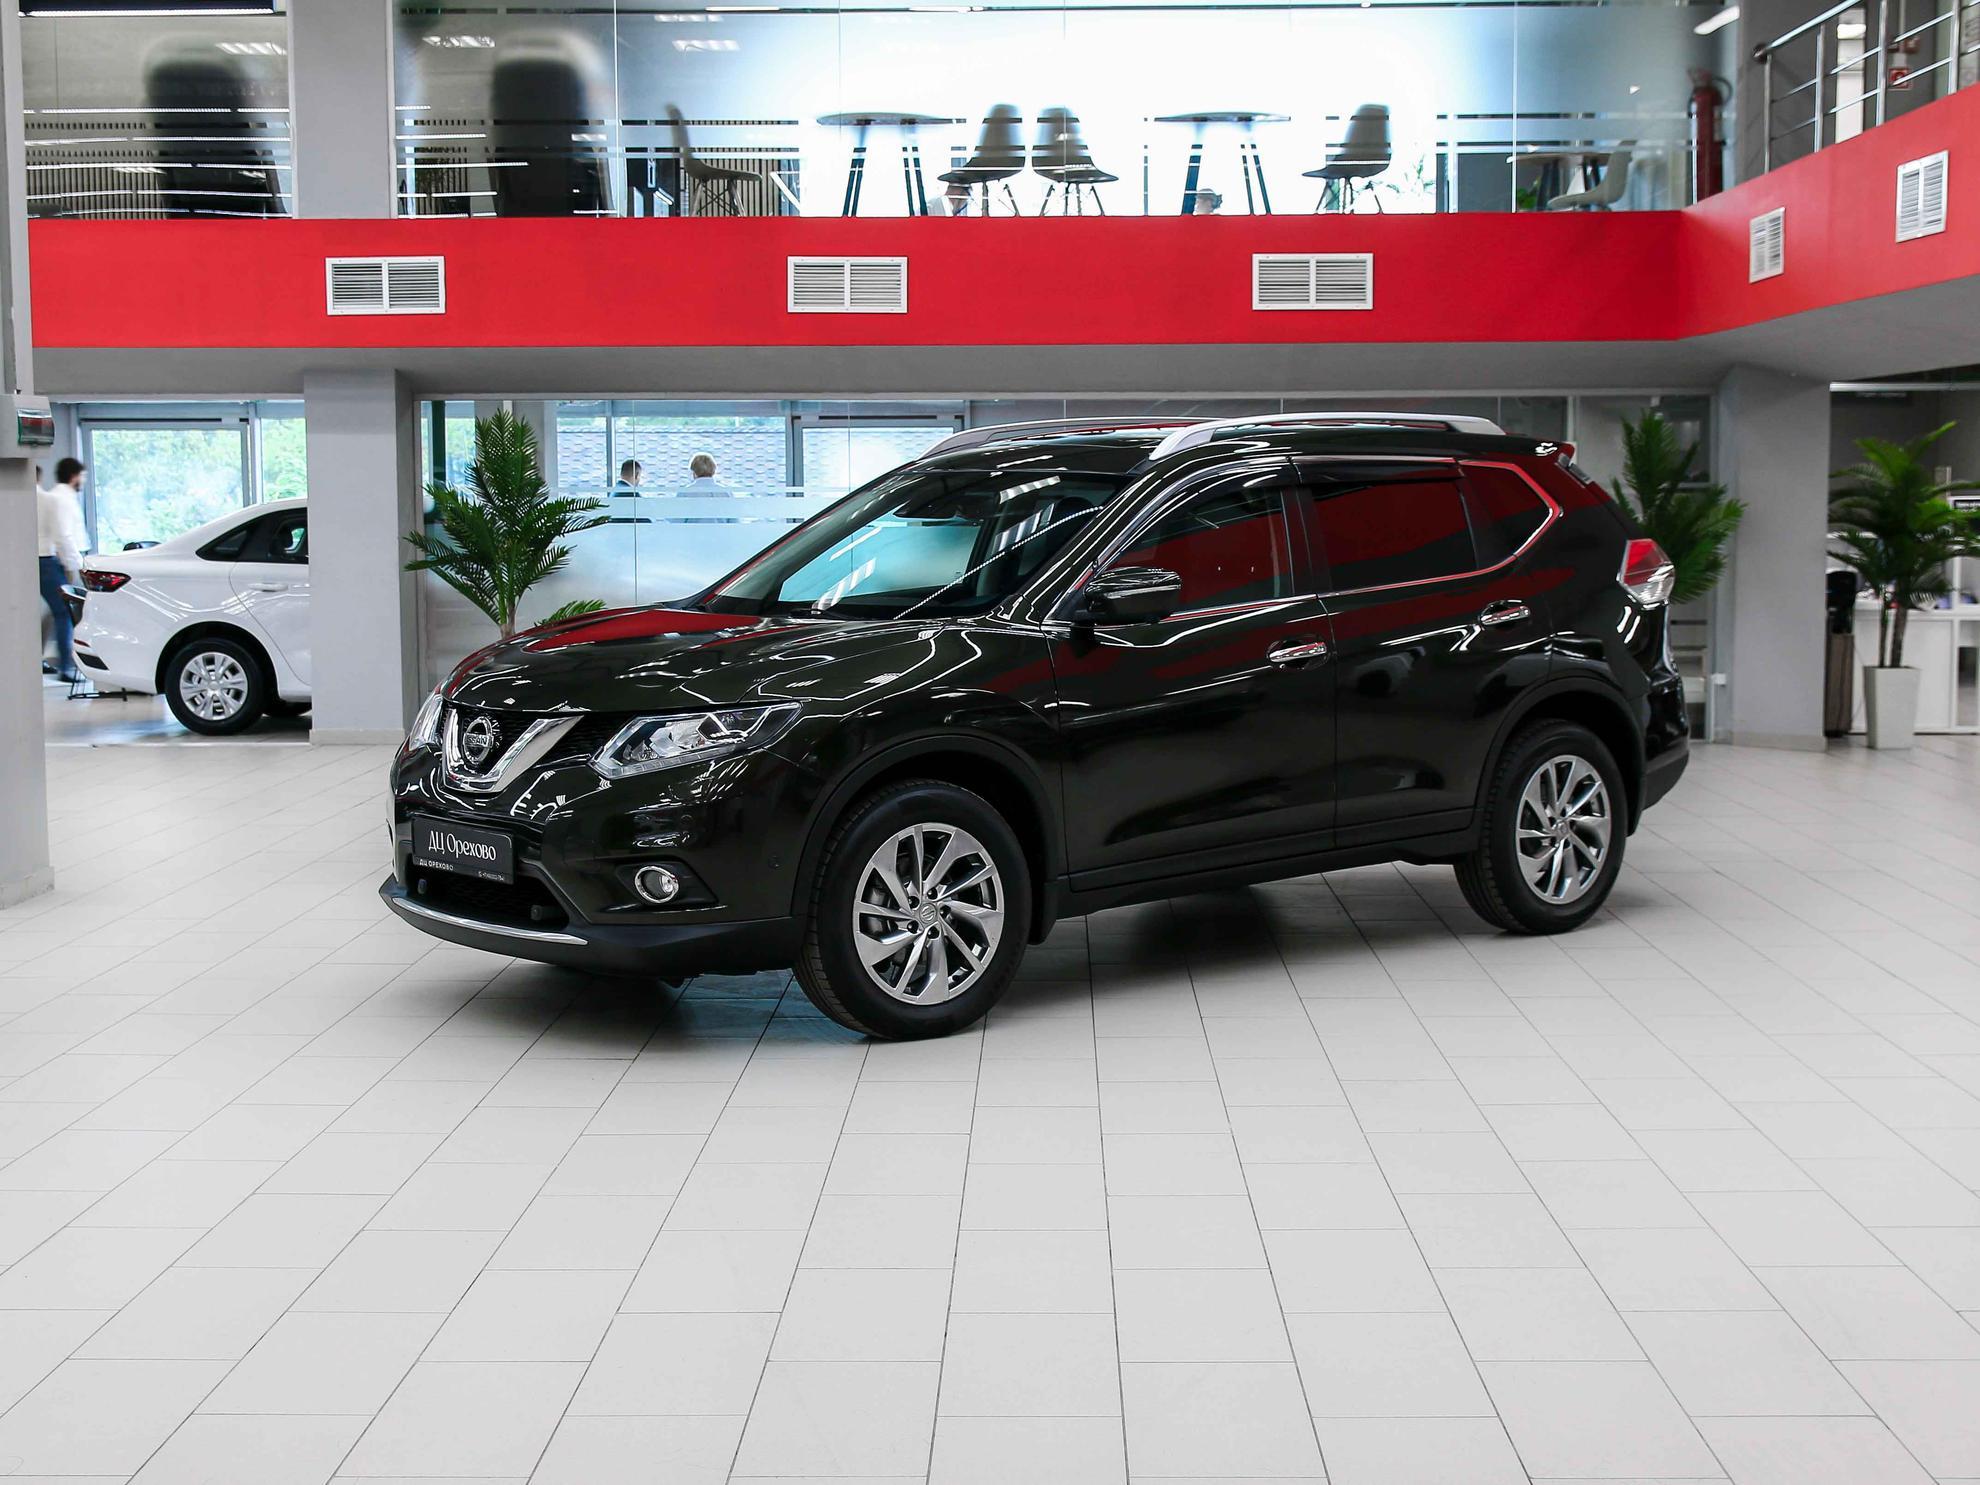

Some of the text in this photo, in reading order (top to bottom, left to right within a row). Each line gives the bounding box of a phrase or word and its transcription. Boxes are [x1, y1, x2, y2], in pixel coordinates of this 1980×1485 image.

[464, 735, 489, 747] SSAN
[428, 830, 497, 861] ДЦ Орехово
[428, 860, 454, 871] ОРЕХОВО
